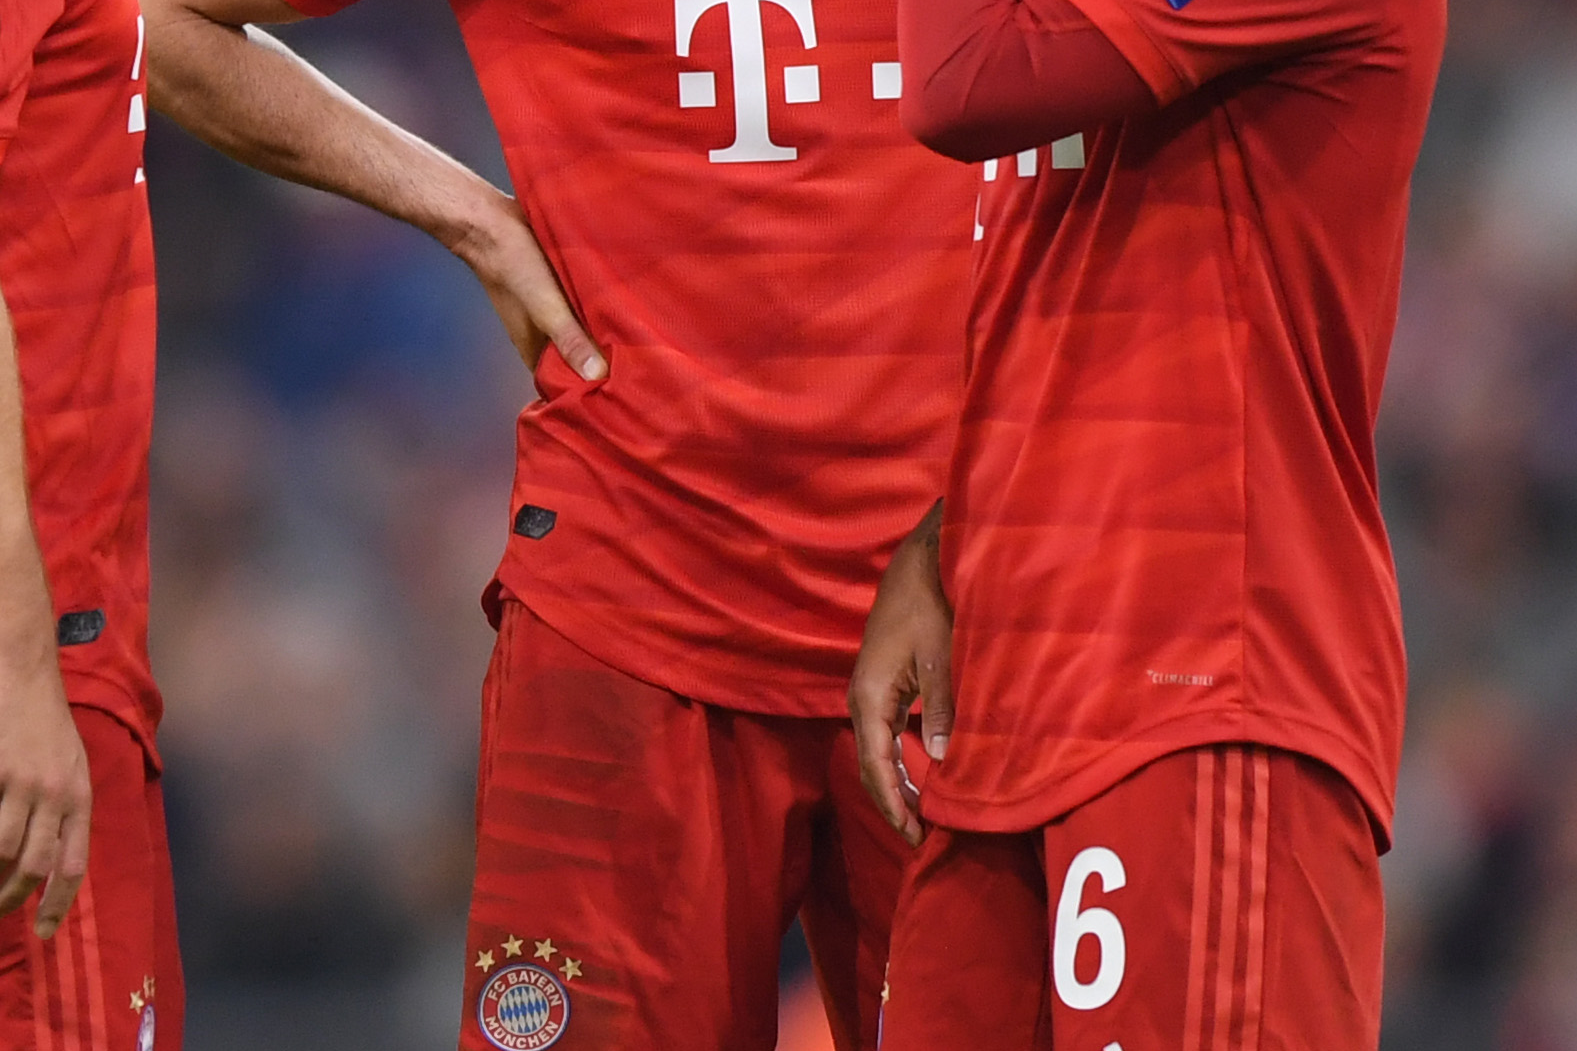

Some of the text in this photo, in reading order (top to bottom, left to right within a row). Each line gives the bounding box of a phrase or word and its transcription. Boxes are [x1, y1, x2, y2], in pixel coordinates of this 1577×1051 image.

[1053, 846, 1126, 1010] 6
[487, 970, 562, 1007] FC BAYERN
